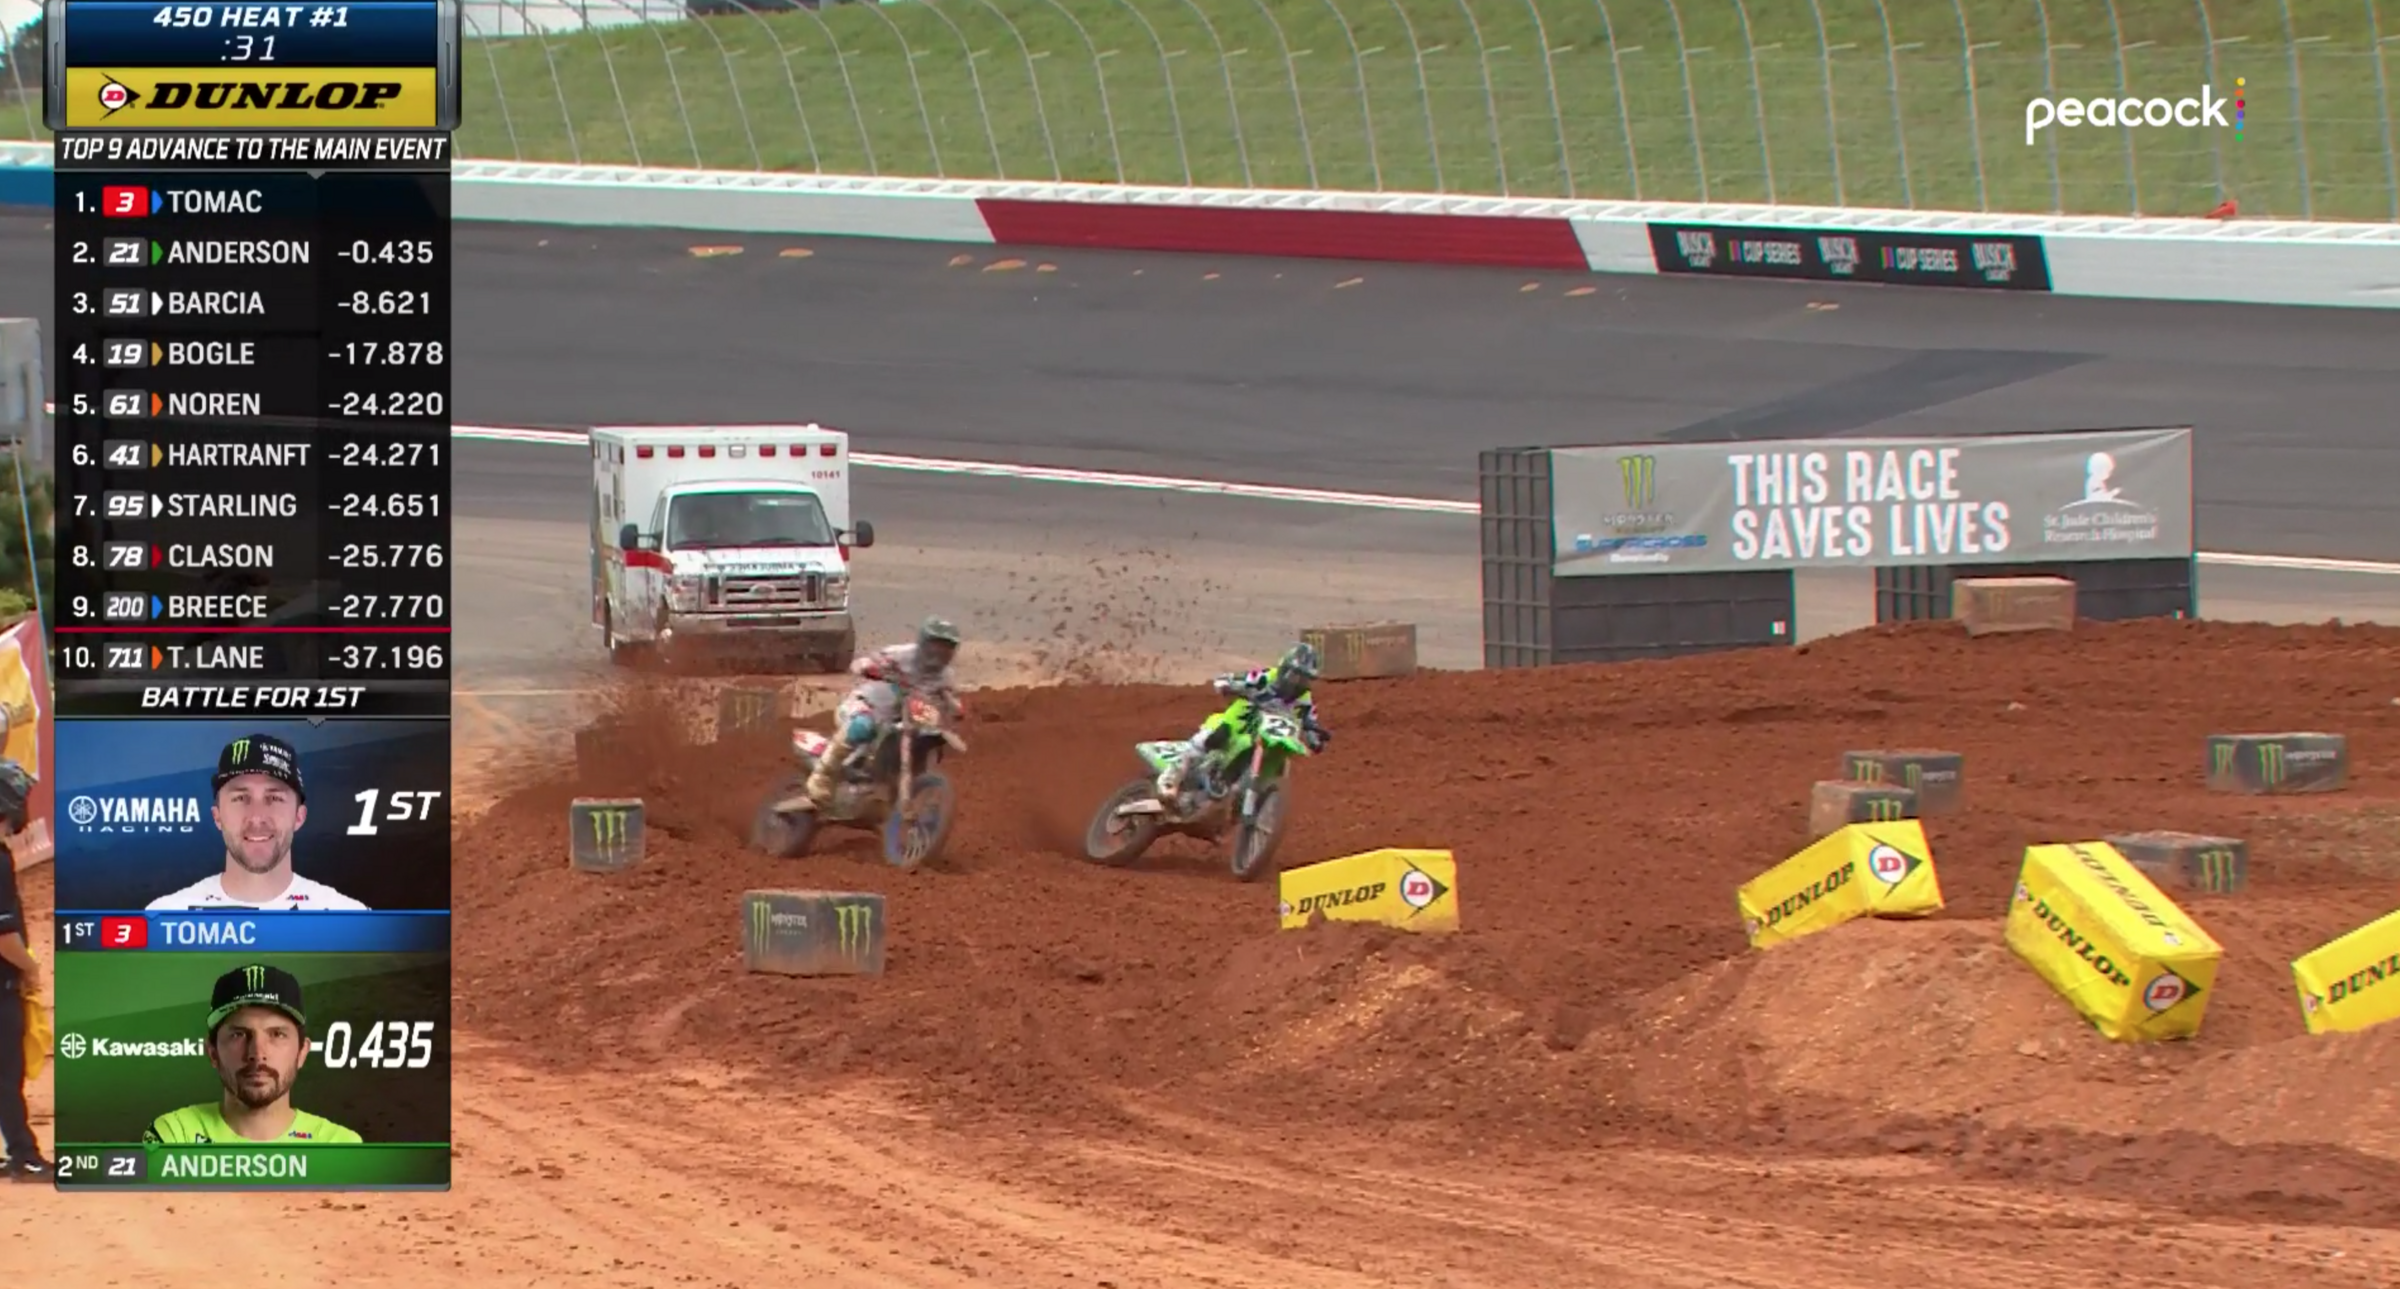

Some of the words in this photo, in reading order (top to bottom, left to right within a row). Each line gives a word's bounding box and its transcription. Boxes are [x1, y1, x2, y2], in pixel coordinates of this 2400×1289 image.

[1743, 240, 1763, 263] CUP
[1764, 241, 1801, 265] SERIES
[1896, 247, 1918, 270] CUP
[1919, 248, 1959, 272] SERIES
[1727, 452, 1828, 506] THIS
[1845, 448, 1961, 503] RACE
[1731, 505, 1873, 560] SAVES
[1889, 501, 2011, 556] LIVES
[1297, 882, 1386, 915] DUNLOP
[1766, 861, 1855, 927] DUNLOP
[2032, 898, 2131, 987] DUNLOP
